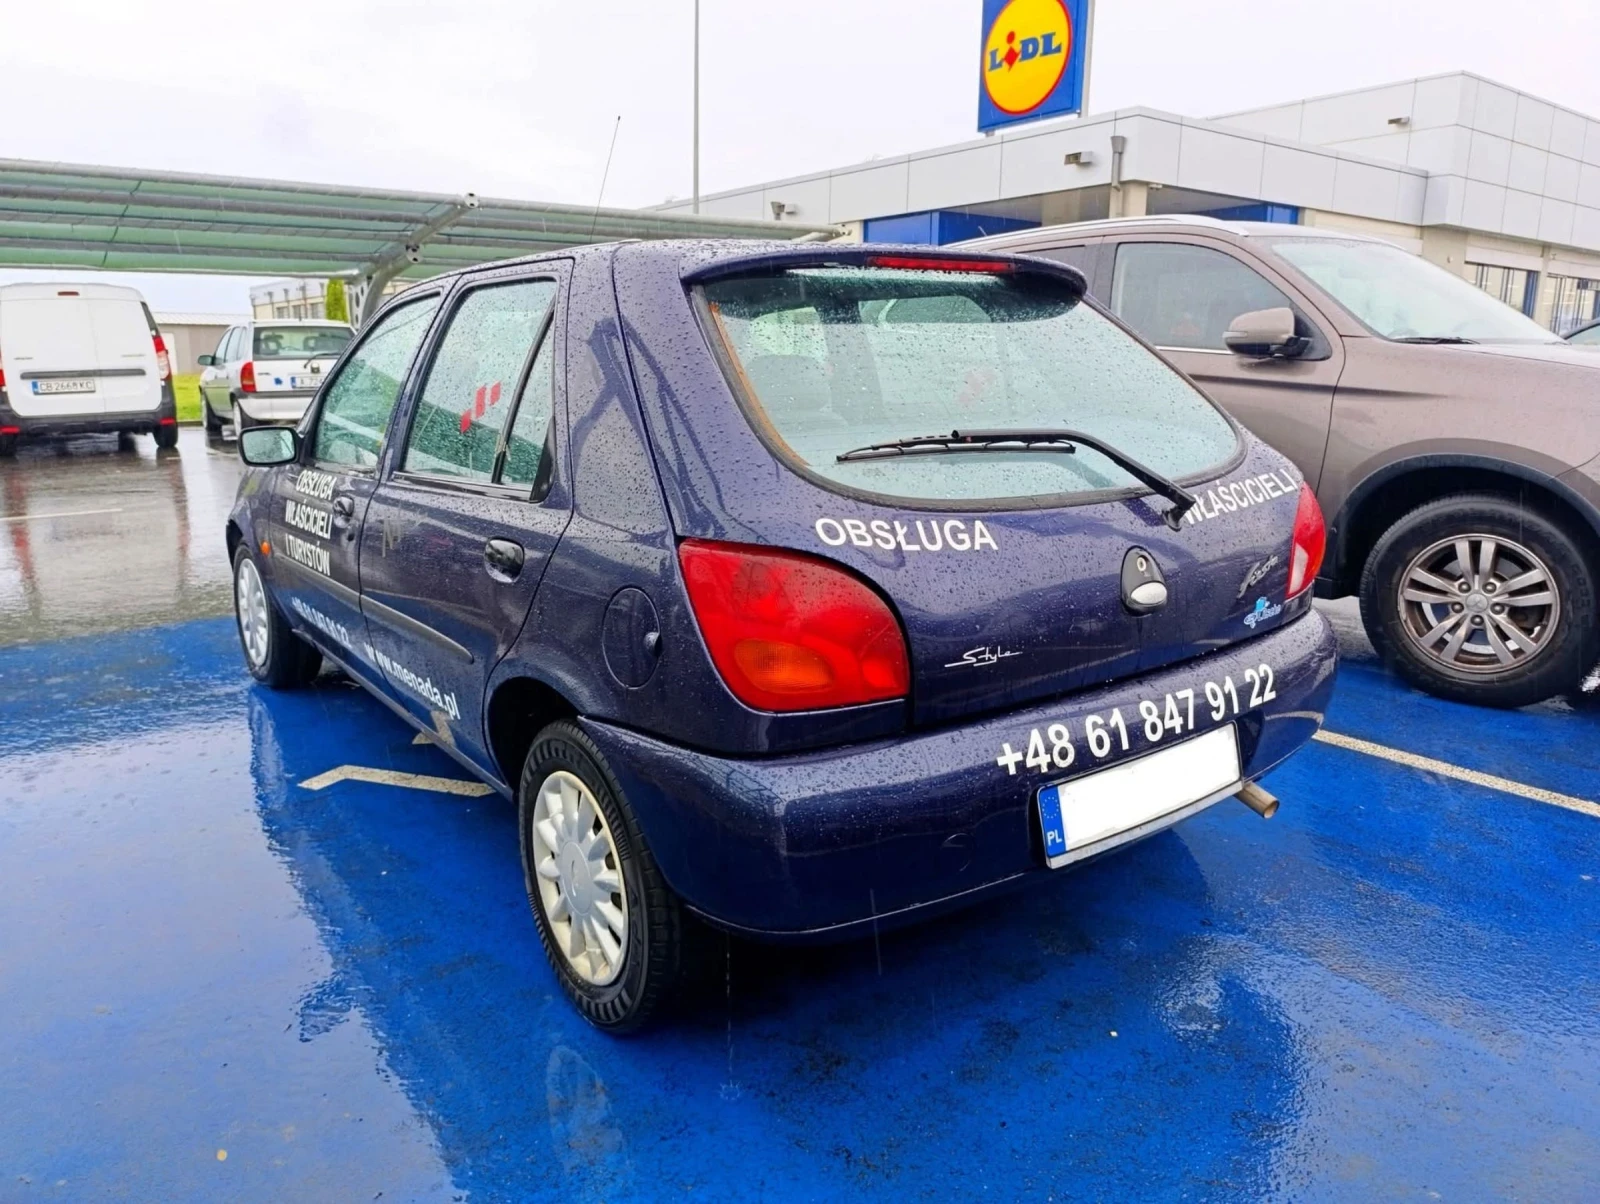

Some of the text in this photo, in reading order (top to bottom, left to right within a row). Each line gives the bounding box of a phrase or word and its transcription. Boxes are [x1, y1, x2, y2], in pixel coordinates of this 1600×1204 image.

[296, 469, 337, 500] OBSŁUGA
[1184, 468, 1299, 525] WŁAŚCICIELI
[815, 517, 999, 551] OBSŁUGA
[289, 534, 331, 576] TURYSTÓW
[944, 646, 1023, 668] Style
[363, 641, 461, 721] www.menada.pl
[996, 663, 1277, 775] +48 61 847 91 22
[1046, 829, 1063, 847] PL
